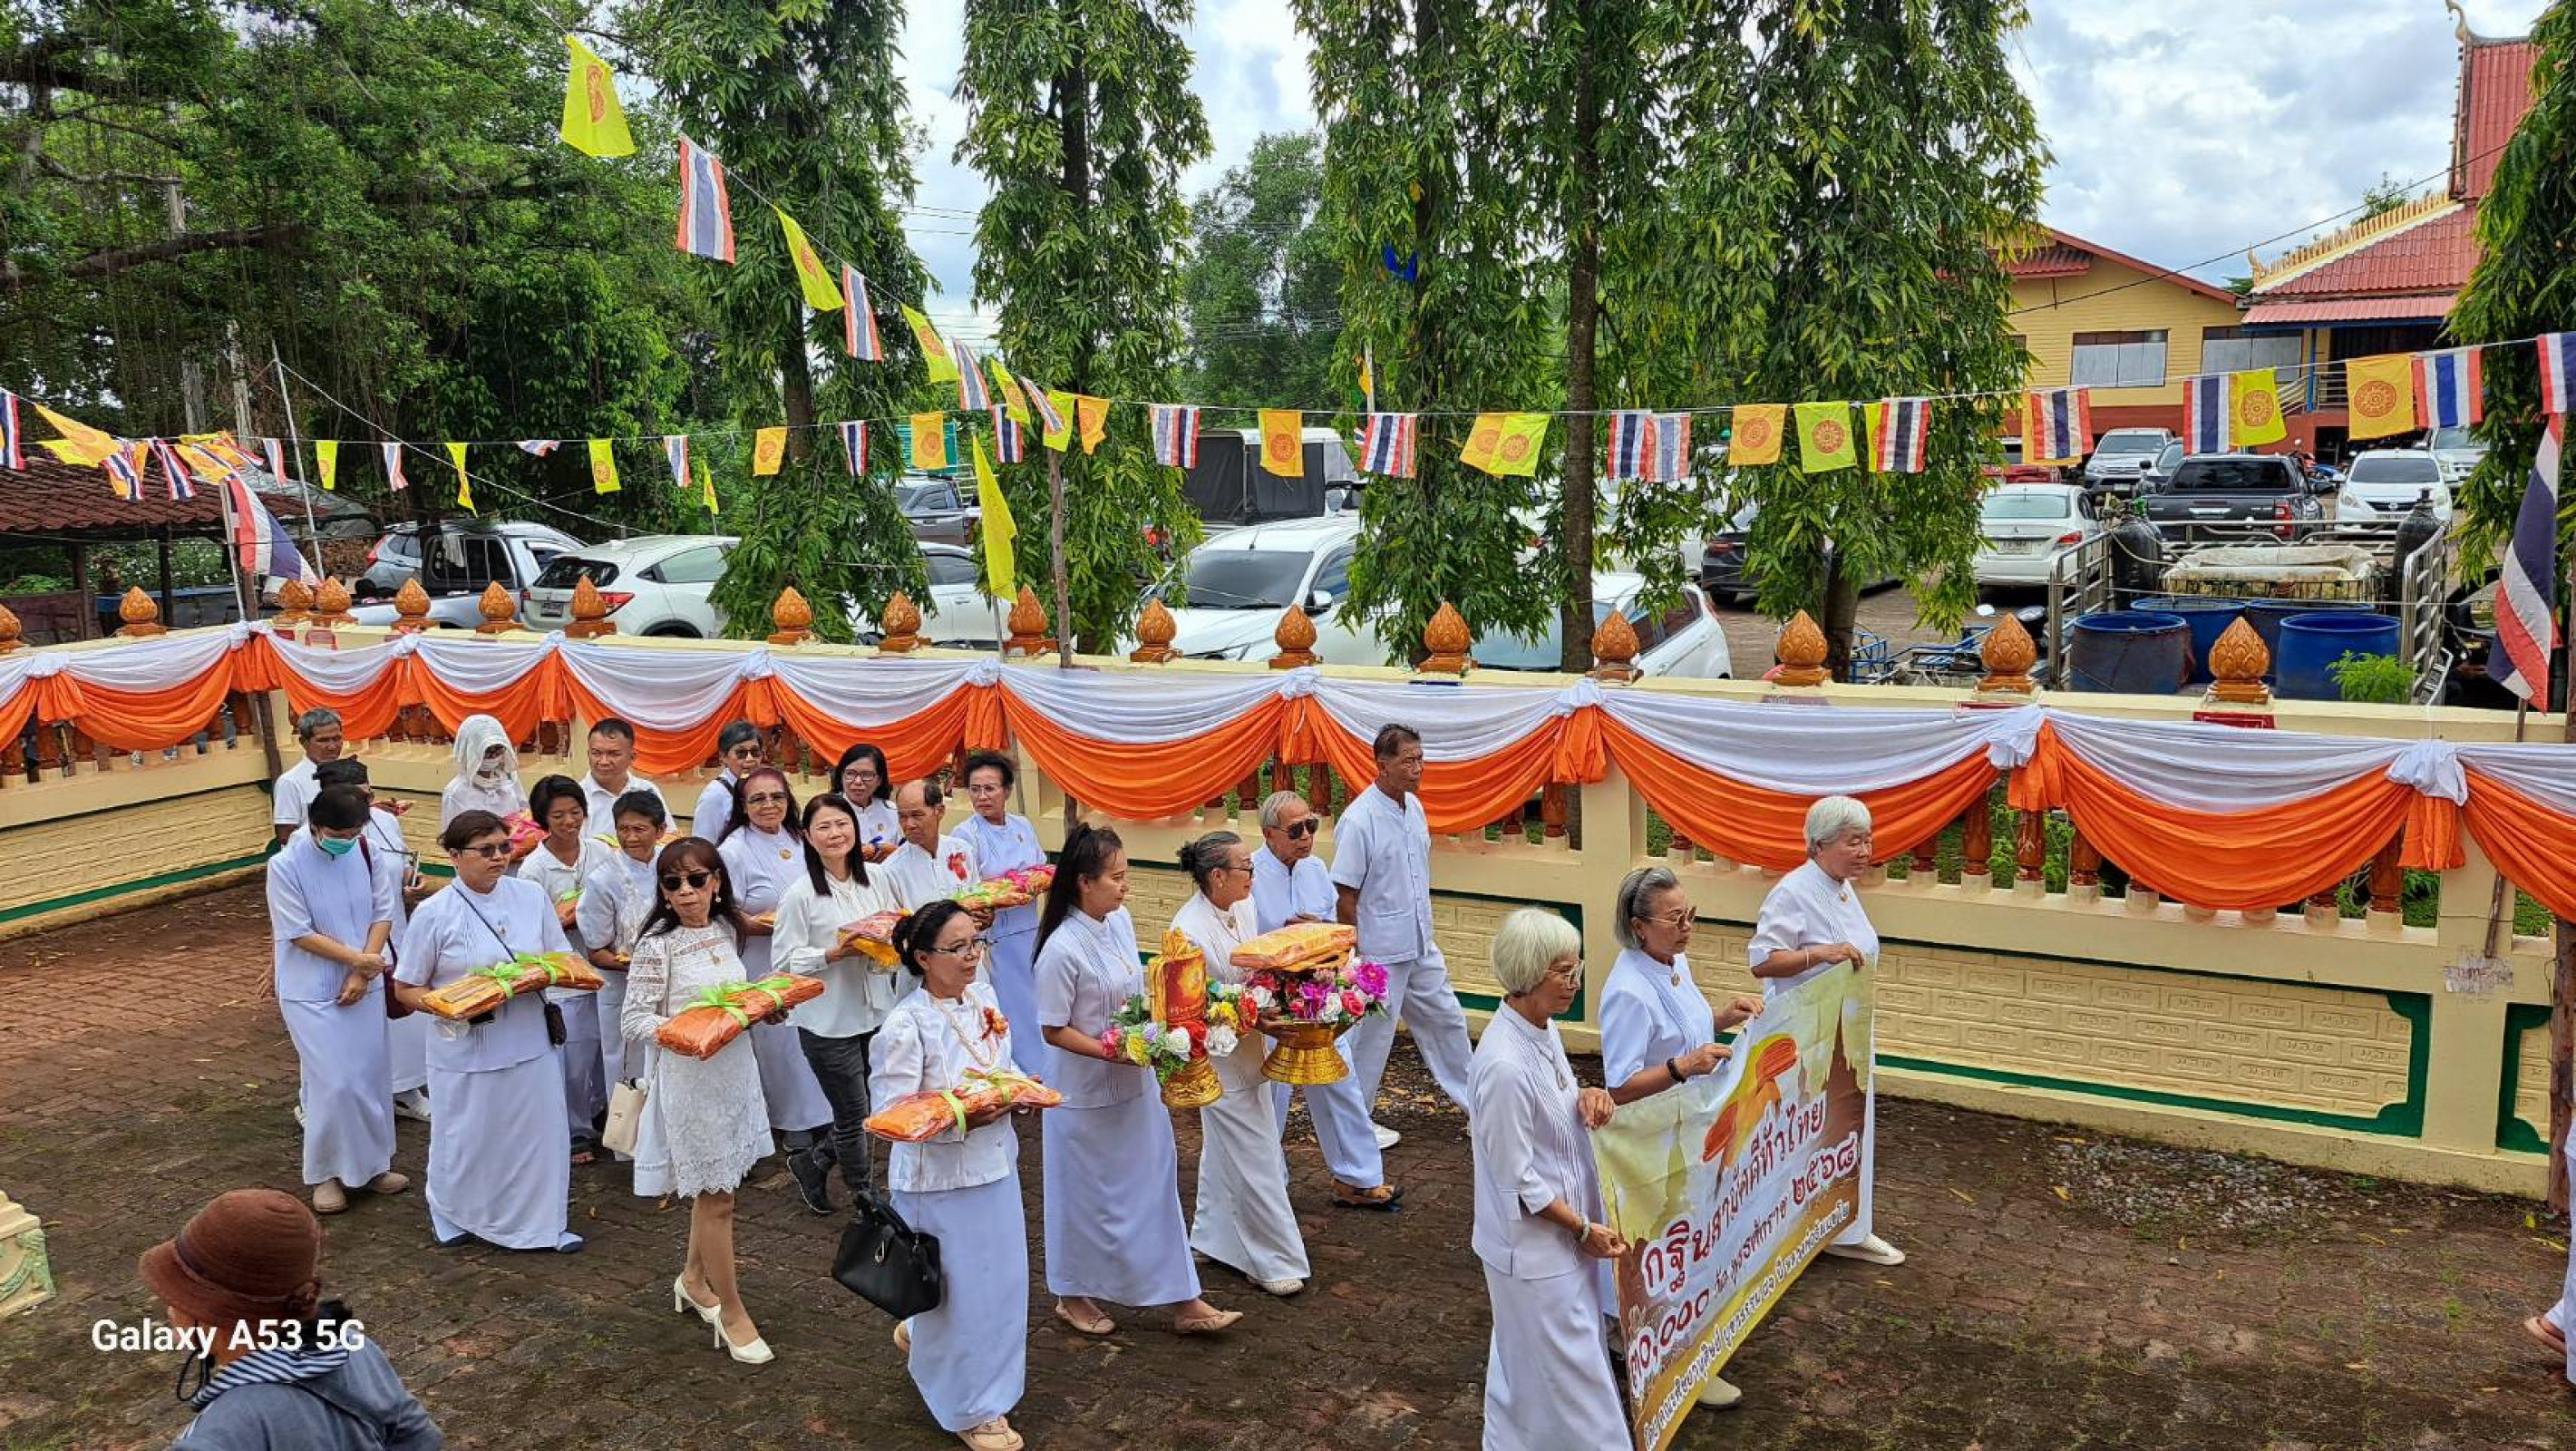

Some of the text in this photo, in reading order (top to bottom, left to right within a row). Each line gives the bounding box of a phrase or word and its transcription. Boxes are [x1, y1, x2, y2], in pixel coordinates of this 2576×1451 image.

[1630, 1288, 1709, 1390] ๓๐,๐๐๐
[1792, 1137, 1856, 1204] ๒๕๖๘
[1645, 1099, 1823, 1292] กฐินสามัคคีทั่วไทย
